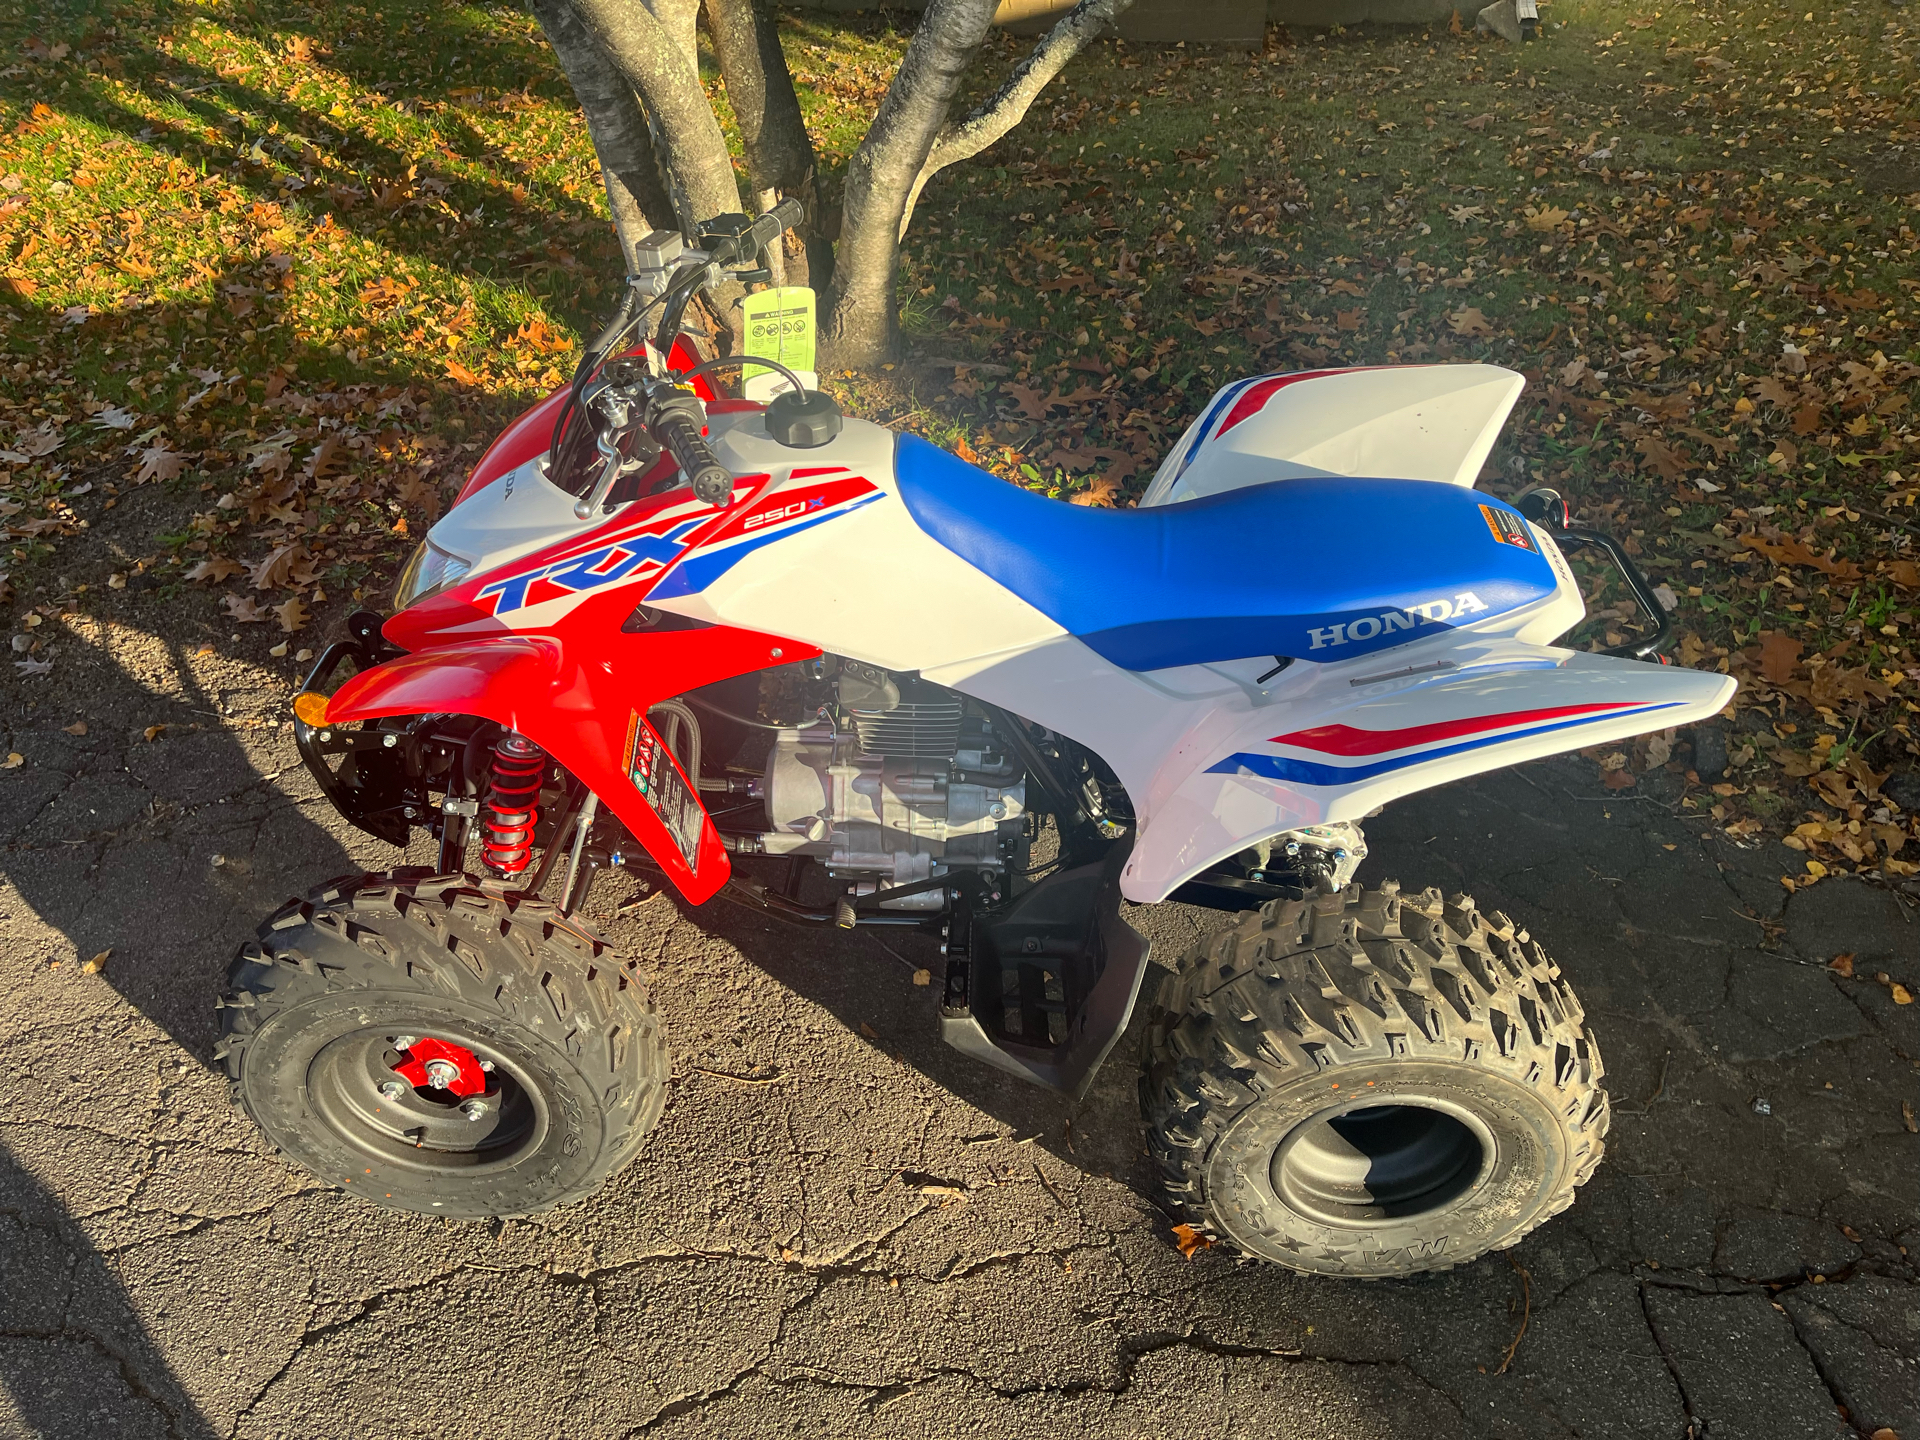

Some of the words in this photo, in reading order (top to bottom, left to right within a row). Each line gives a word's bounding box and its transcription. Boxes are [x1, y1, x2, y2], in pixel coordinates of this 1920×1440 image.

[504, 470, 516, 501] NDA
[476, 513, 720, 616] TRX
[1306, 591, 1489, 650] HONDA
[1239, 1208, 1449, 1265] MAXXIS
